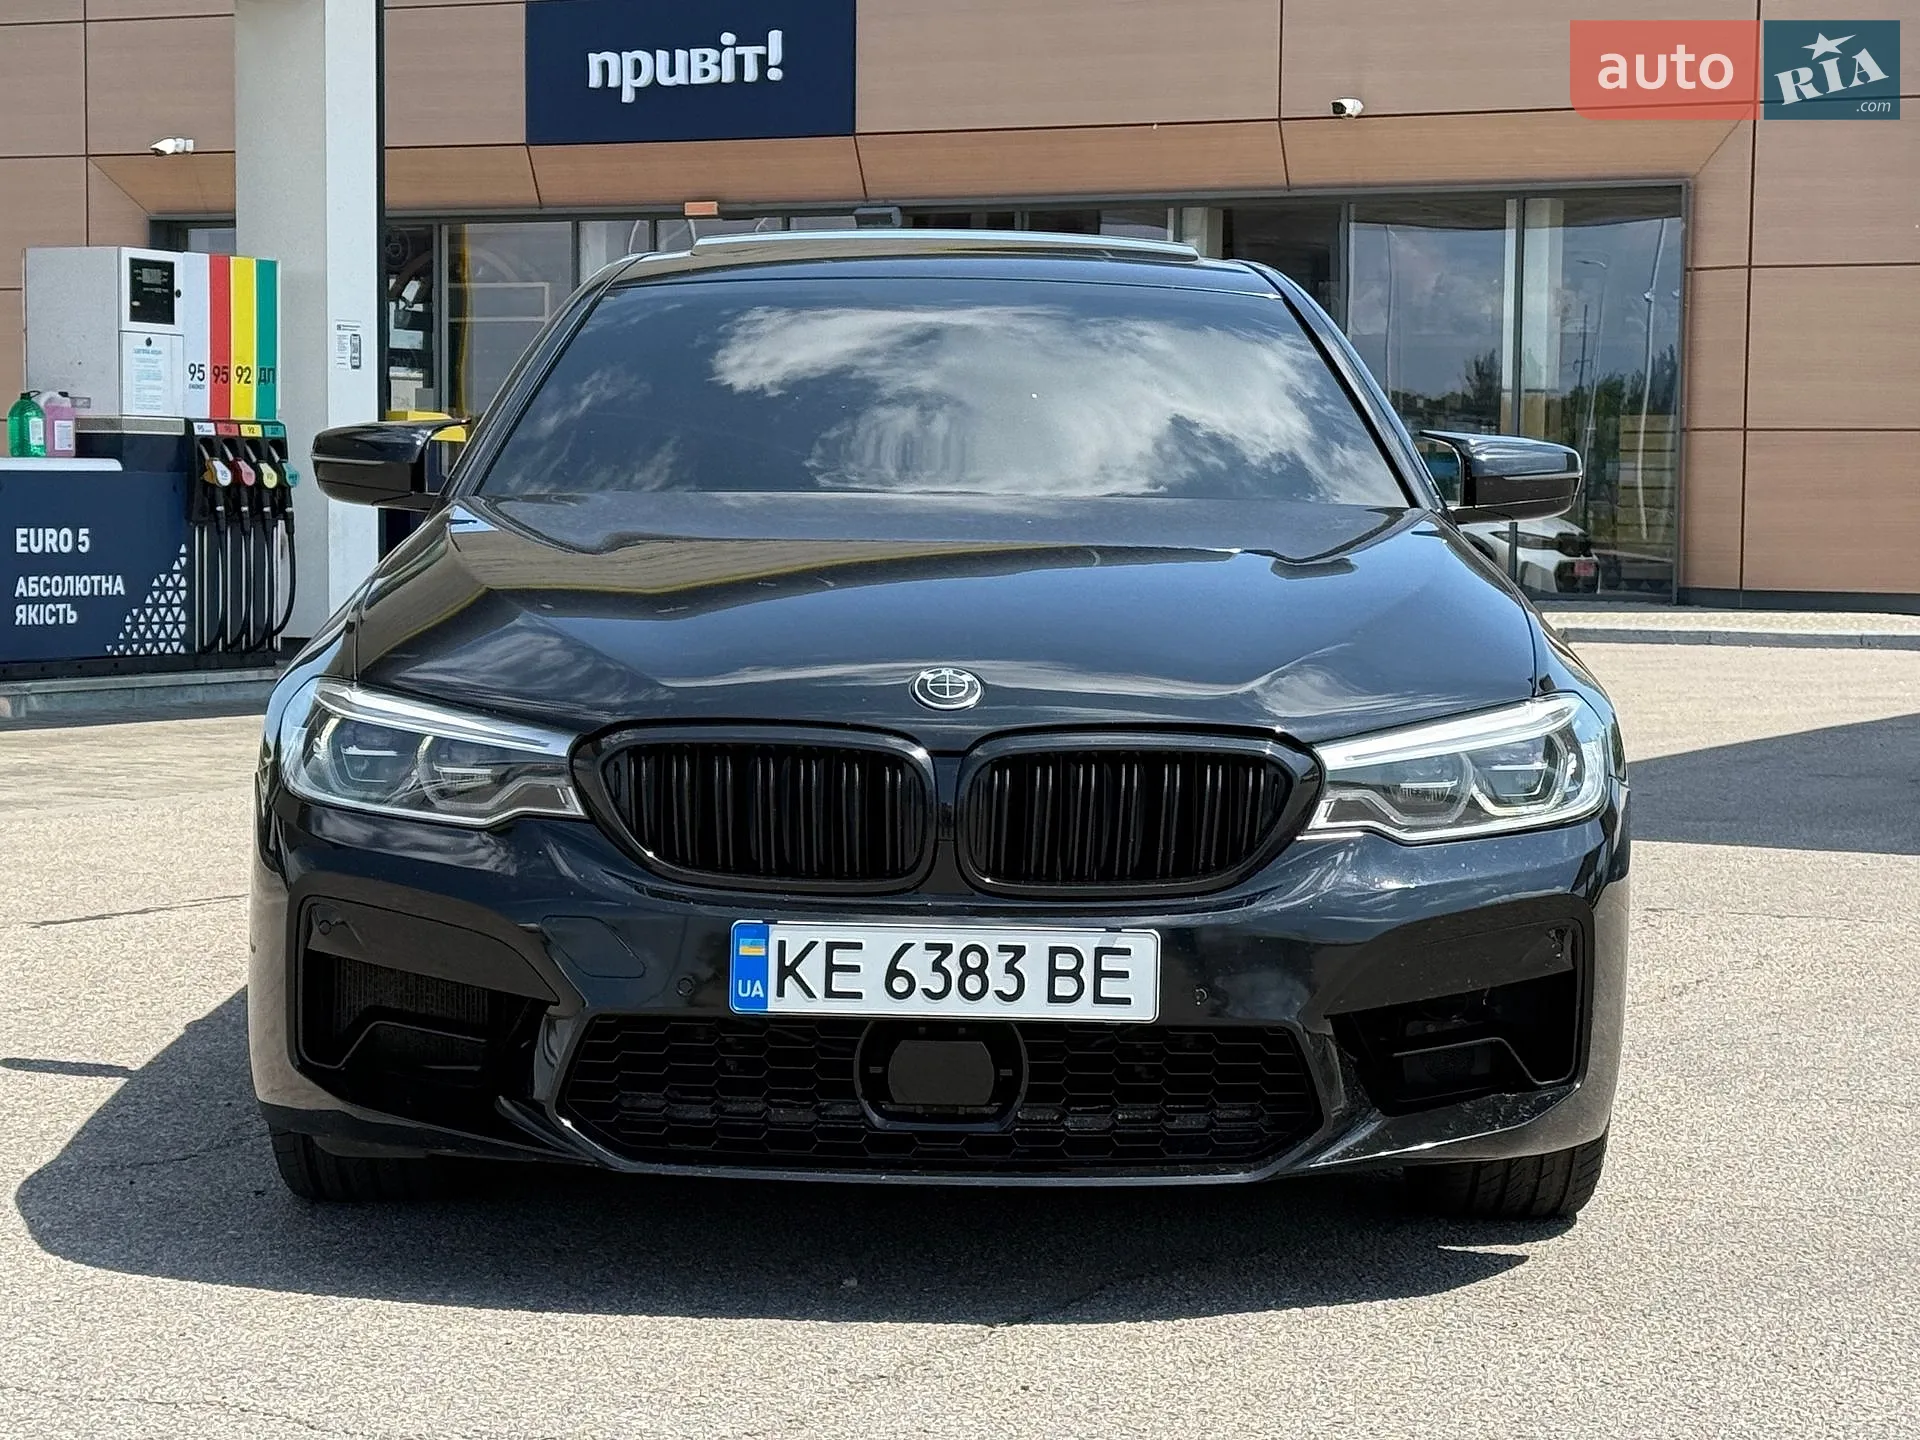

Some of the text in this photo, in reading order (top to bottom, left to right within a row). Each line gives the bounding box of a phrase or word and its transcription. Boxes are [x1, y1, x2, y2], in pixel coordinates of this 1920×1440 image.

[588, 29, 783, 103] привіт!
[188, 363, 206, 382] 95
[212, 365, 229, 384] 95
[235, 366, 252, 384] 92
[258, 367, 275, 386] ДП
[15, 528, 90, 553] EURO 5
[15, 575, 125, 597] АБСОЛЮТНА
[15, 603, 78, 625] ЯКІСТЬ
[775, 939, 1132, 1005] KE 6383 BE
[738, 980, 764, 998] UA
